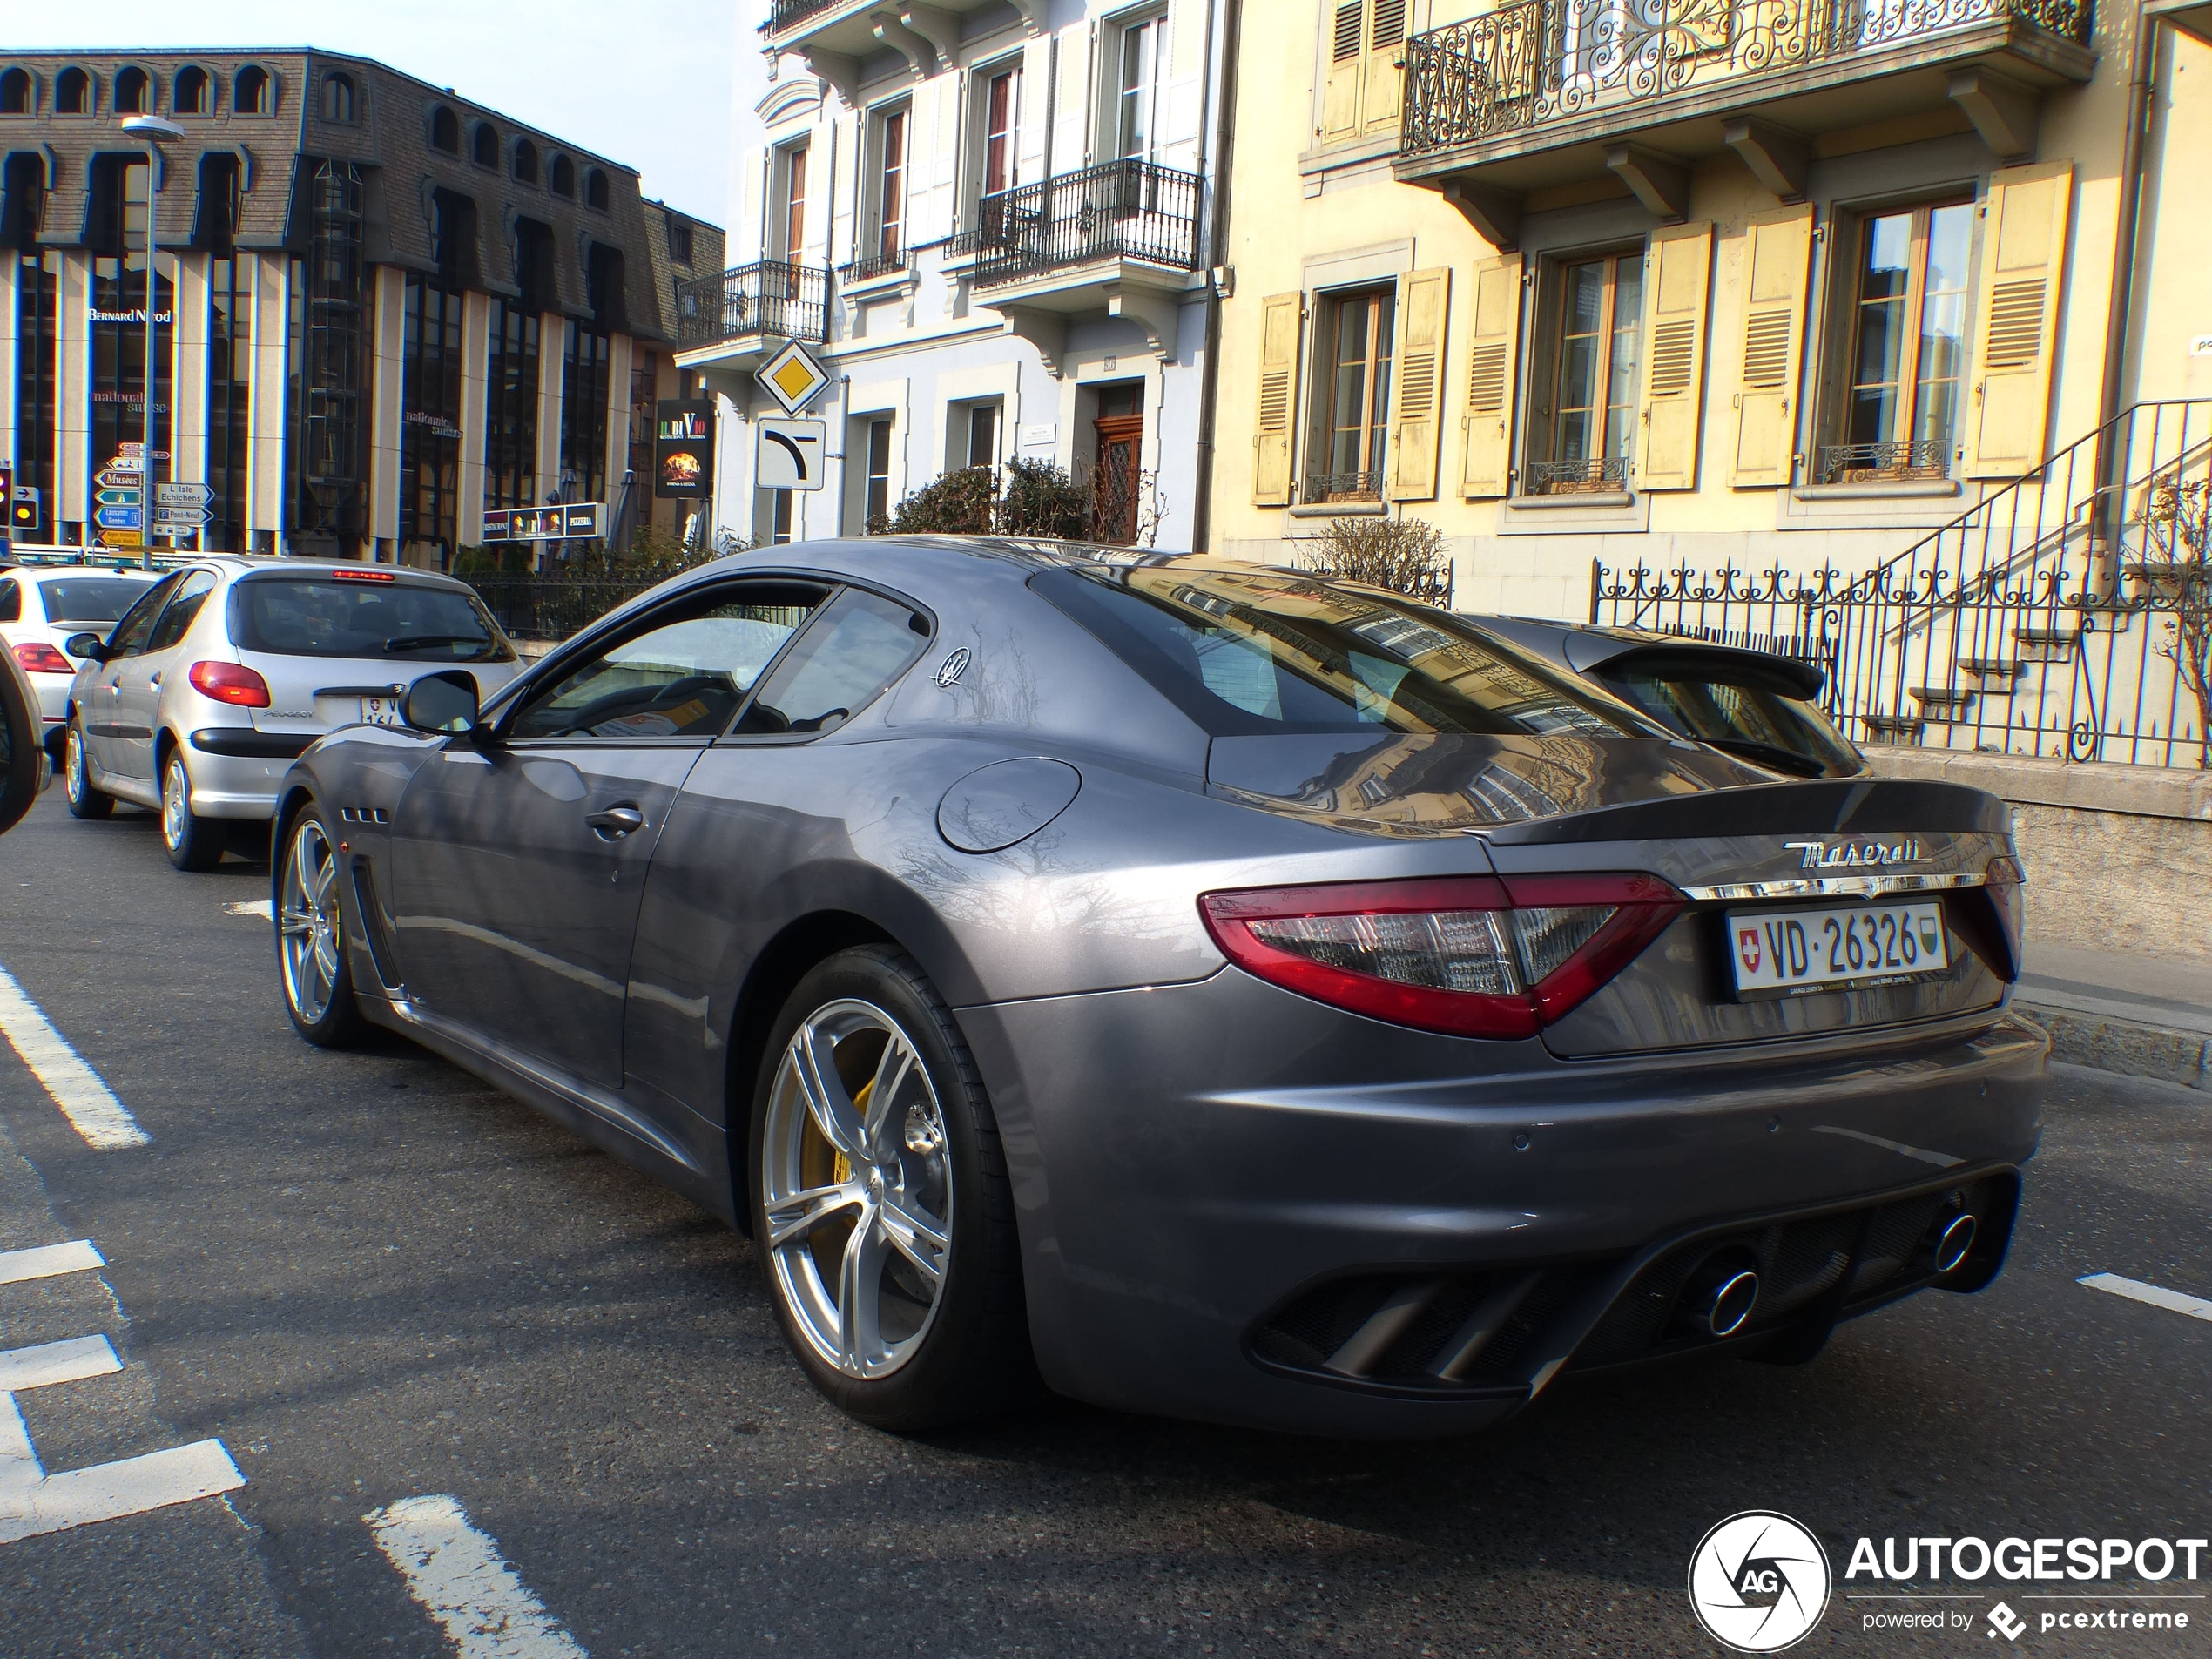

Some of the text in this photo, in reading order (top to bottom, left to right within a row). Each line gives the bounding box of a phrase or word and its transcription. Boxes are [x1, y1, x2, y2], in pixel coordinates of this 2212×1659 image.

[137, 308, 171, 322] Nod
[127, 402, 166, 413] suse
[406, 411, 450, 428] nationale
[660, 421, 670, 435] IL
[106, 473, 138, 485] Musées
[161, 493, 201, 502] Echichens
[170, 510, 200, 519] Pont-Neuf
[263, 710, 315, 718] PEUGEOT
[1784, 840, 1932, 868] Maserati
